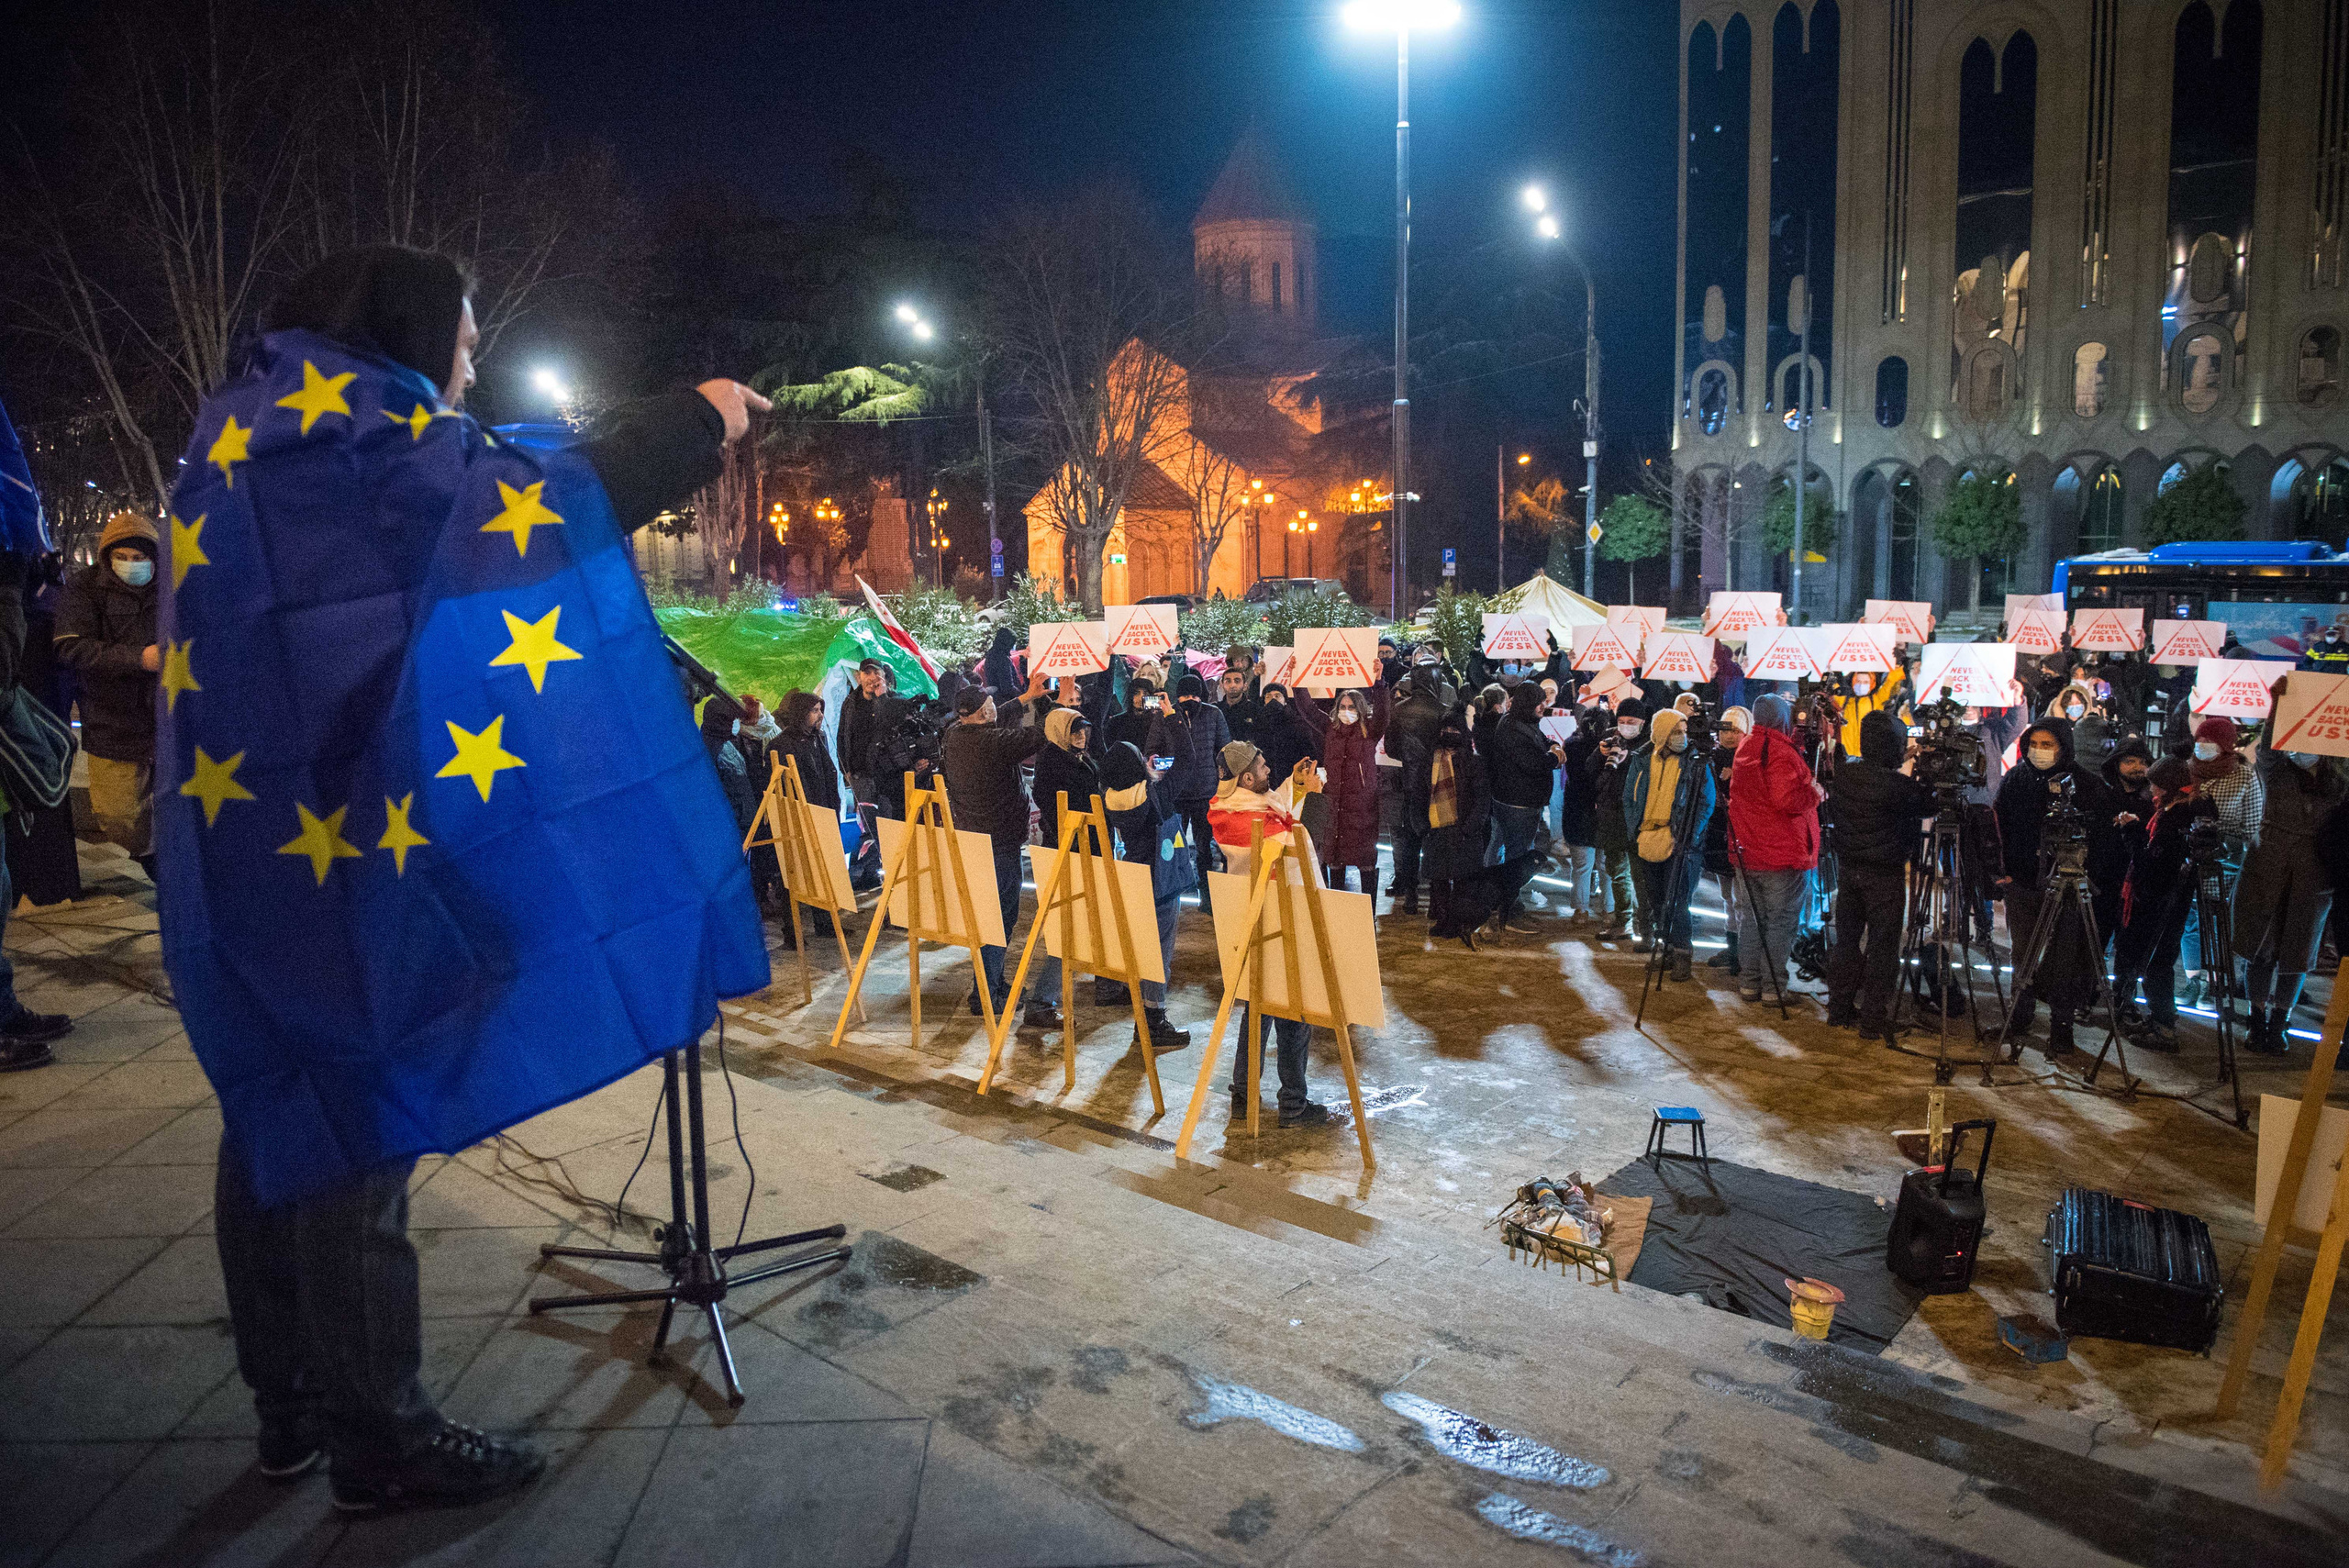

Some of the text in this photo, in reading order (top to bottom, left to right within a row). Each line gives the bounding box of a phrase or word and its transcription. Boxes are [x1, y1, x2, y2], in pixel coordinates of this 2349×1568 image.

[1445, 550, 1453, 562] P
[1123, 638, 1161, 646] USSR
[2019, 638, 2049, 646] USSR
[1589, 653, 1623, 662] USSR
[2168, 649, 2205, 657] USSR
[1049, 657, 1090, 667] USSR
[1766, 662, 1809, 670] USSR
[1313, 667, 1356, 676] USSR
[1660, 663, 1694, 673] USSR
[1954, 684, 1989, 694] SSR
[2219, 696, 2266, 706] USSR
[2324, 705, 2349, 715] NEV
[2308, 725, 2349, 740] US
